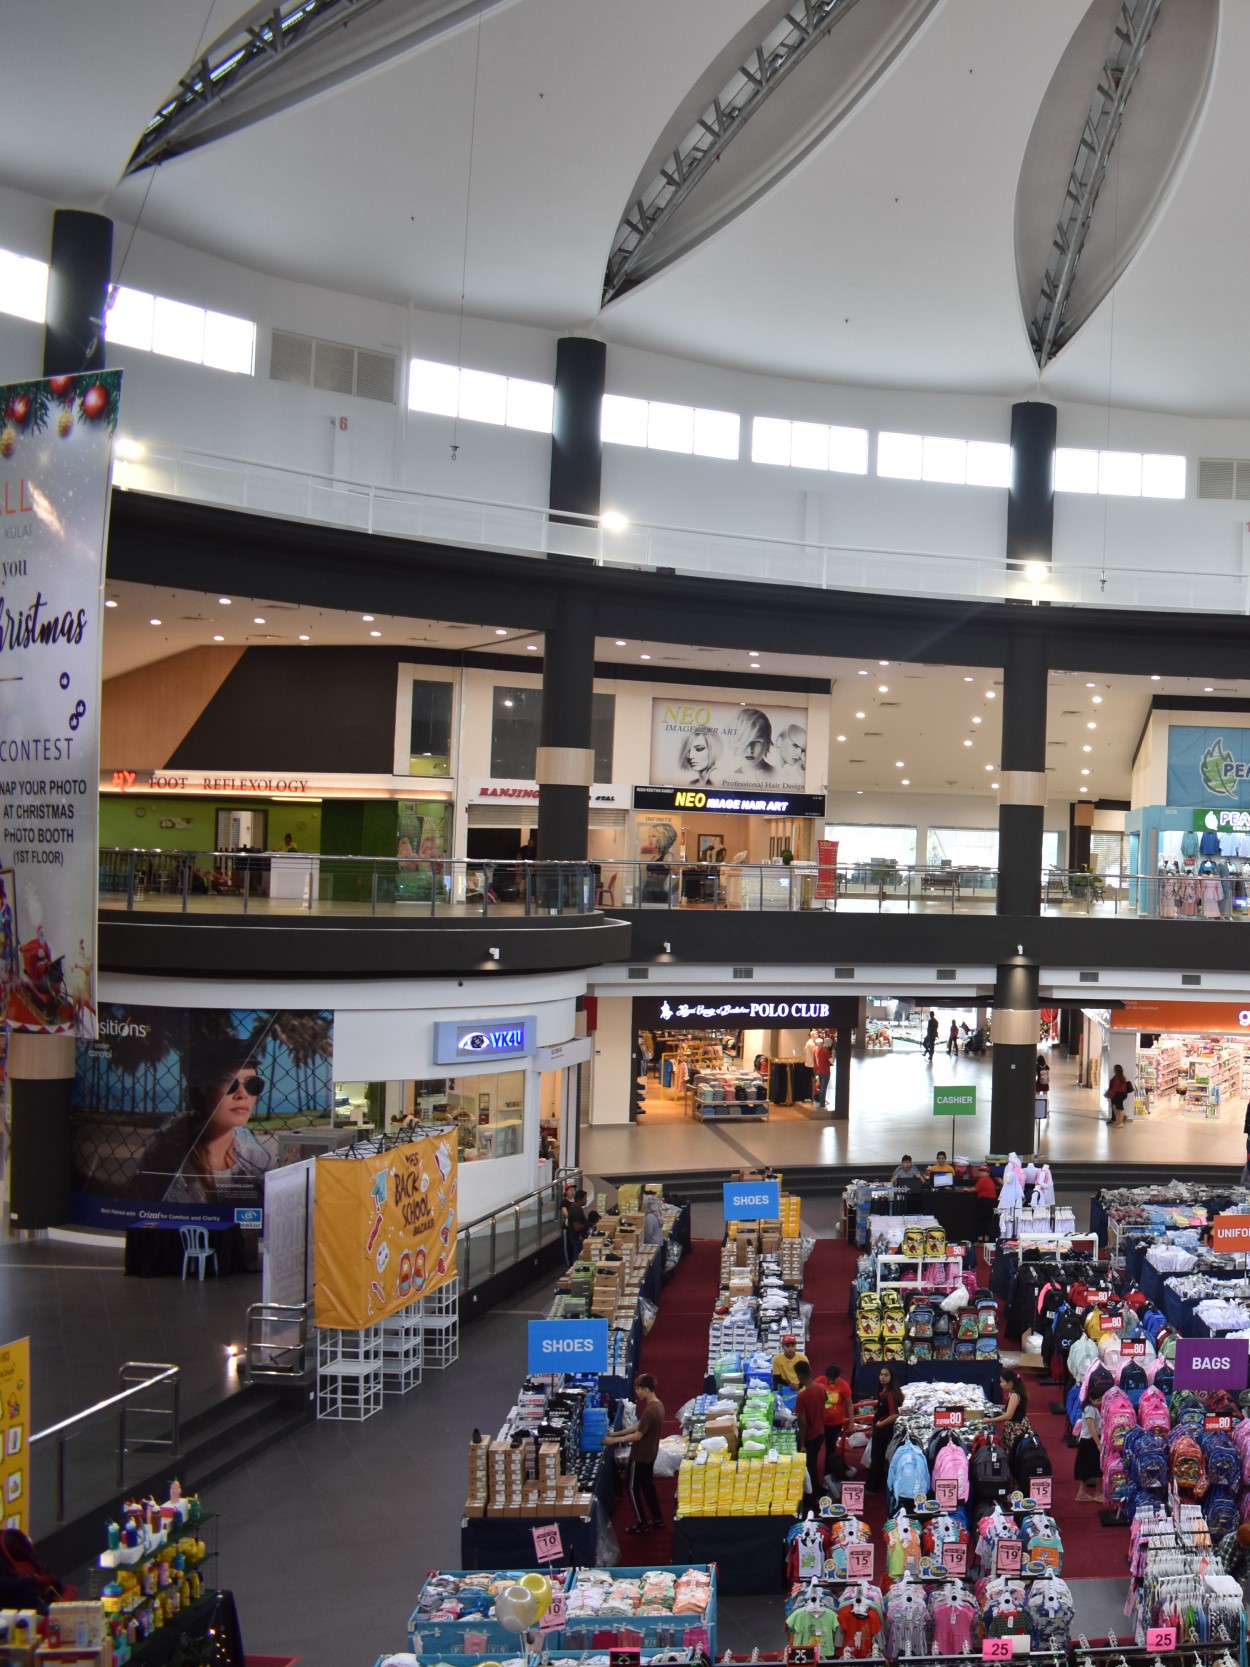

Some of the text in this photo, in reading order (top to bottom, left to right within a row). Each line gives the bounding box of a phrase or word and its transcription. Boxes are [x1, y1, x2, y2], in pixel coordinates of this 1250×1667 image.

[340, 416, 348, 431] 6
[2, 559, 28, 586] you
[661, 703, 711, 726] NEO
[720, 728, 738, 736] ART
[0, 737, 74, 763] CONTEST
[0, 779, 87, 796] NAP YOUR PHOTO
[150, 776, 309, 793] FOOT REFLEXOLOGY
[722, 779, 805, 791] Professional Hair Design
[674, 791, 789, 812] NEO IMAGE HAIR ART
[4, 803, 75, 819] AT CHRISTMAS
[4, 827, 74, 844] PHOTO BOOTH
[31, 850, 64, 867] FLOOR)
[750, 1003, 789, 1017] POLO
[791, 1003, 830, 1017] CLUB
[100, 1018, 147, 1038] sitions
[936, 1095, 973, 1105] CASHIER
[394, 1171, 420, 1208] BACK
[733, 1195, 769, 1206] SHOES
[139, 1210, 160, 1219] Crizal
[402, 1193, 431, 1228] SCHOOL
[1098, 1291, 1107, 1301] 80
[1111, 1316, 1122, 1327] 80
[542, 1338, 594, 1353] SHOES
[1133, 1343, 1144, 1354] 80
[1192, 1357, 1231, 1370] BAGS
[949, 1412, 962, 1425] 80
[1218, 1416, 1230, 1429] 80
[848, 1492, 861, 1501] 15
[942, 1489, 954, 1498] 15
[1036, 1486, 1048, 1496] 15
[543, 1535, 556, 1547] 10
[855, 1555, 869, 1566] 15
[949, 1553, 963, 1563] 19
[1004, 1550, 1018, 1560] 19
[548, 1603, 560, 1615] 10
[1155, 1633, 1172, 1647] 25
[991, 1643, 1008, 1656] 25
[618, 1653, 630, 1665] 25
[794, 1649, 807, 1664] 25
